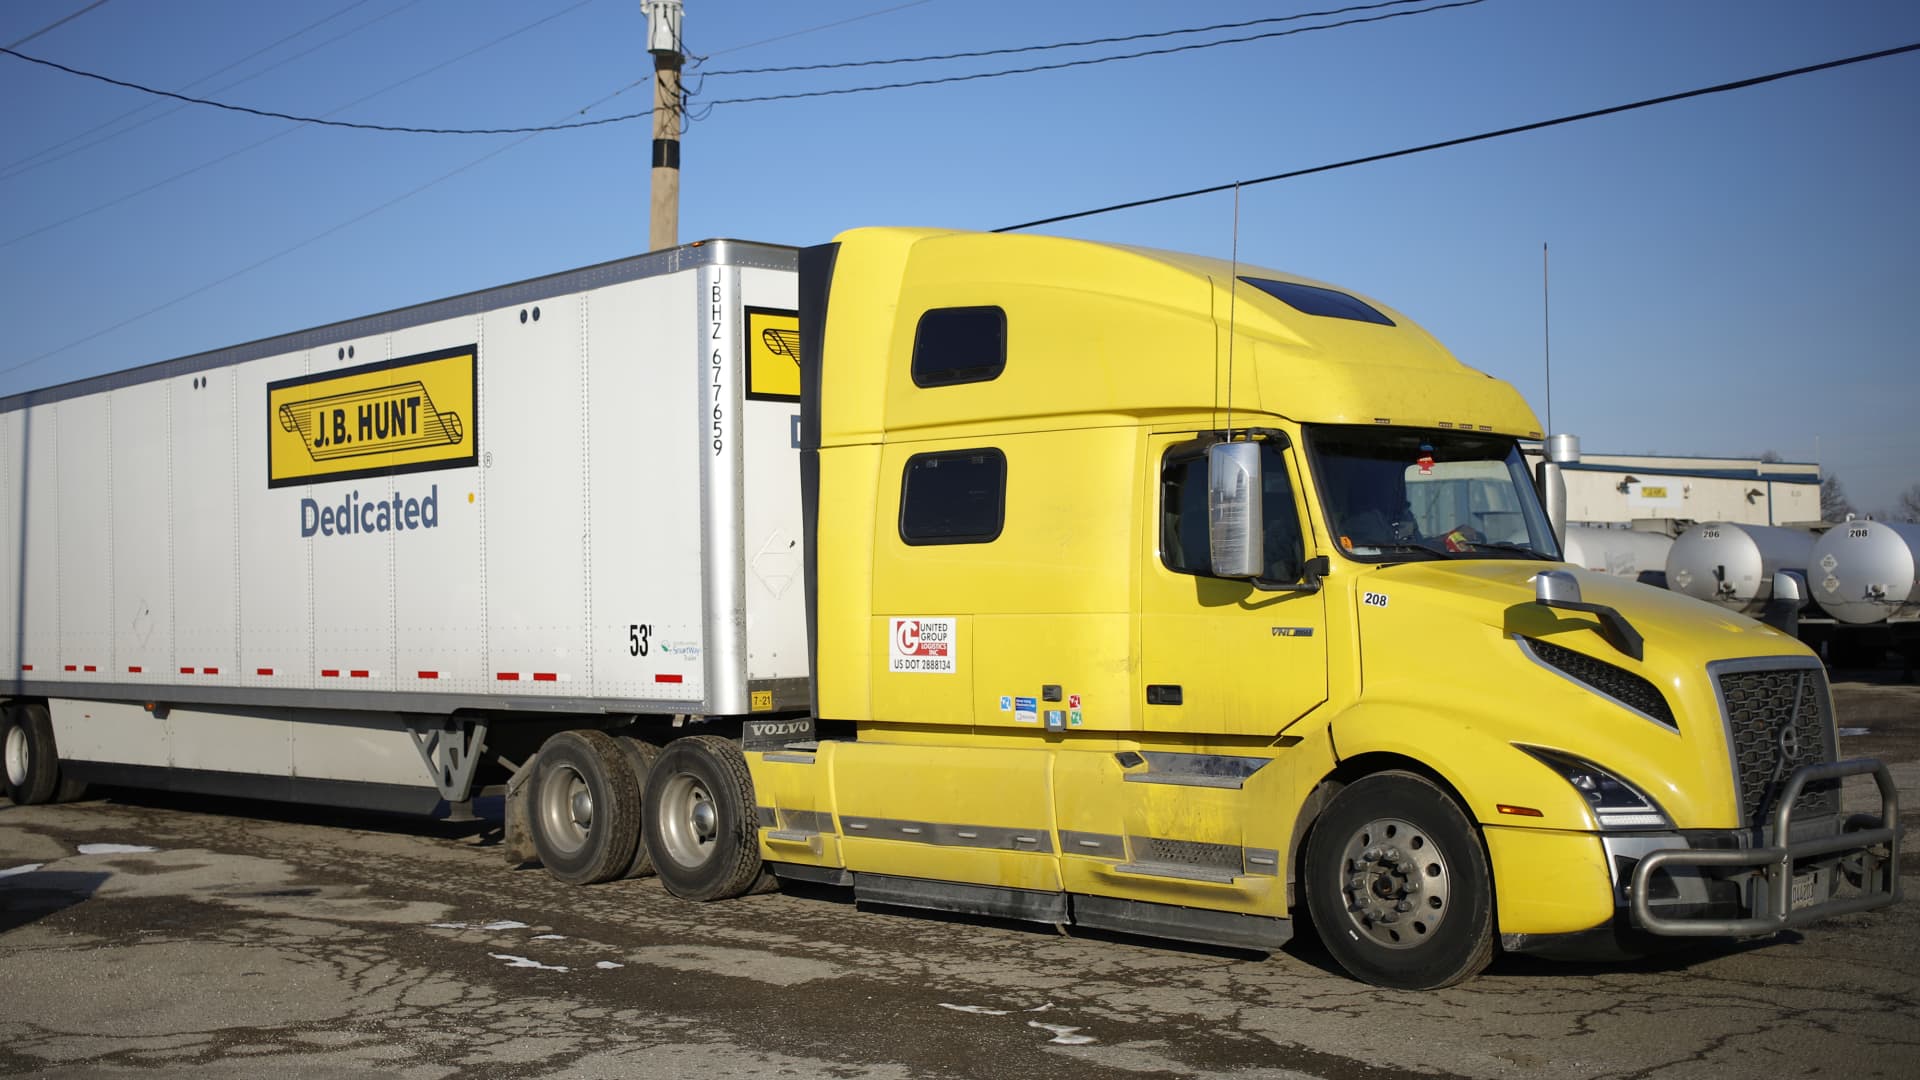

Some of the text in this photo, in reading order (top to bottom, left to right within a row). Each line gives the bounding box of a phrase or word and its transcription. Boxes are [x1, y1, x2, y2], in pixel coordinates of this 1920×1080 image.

[712, 267, 723, 457] JBHZ 677659
[358, 396, 421, 441] HUNT
[301, 484, 438, 538] Dedicated
[1703, 530, 1720, 539] 206
[1849, 529, 1868, 538] 208
[1364, 593, 1387, 606] 208
[920, 623, 948, 632] UNITED
[629, 624, 652, 657] 53'
[920, 632, 948, 642] GROUP
[920, 642, 947, 650] LOGISTICS
[894, 659, 951, 670] US DOT 2888134
[750, 721, 810, 736] VOLVO
